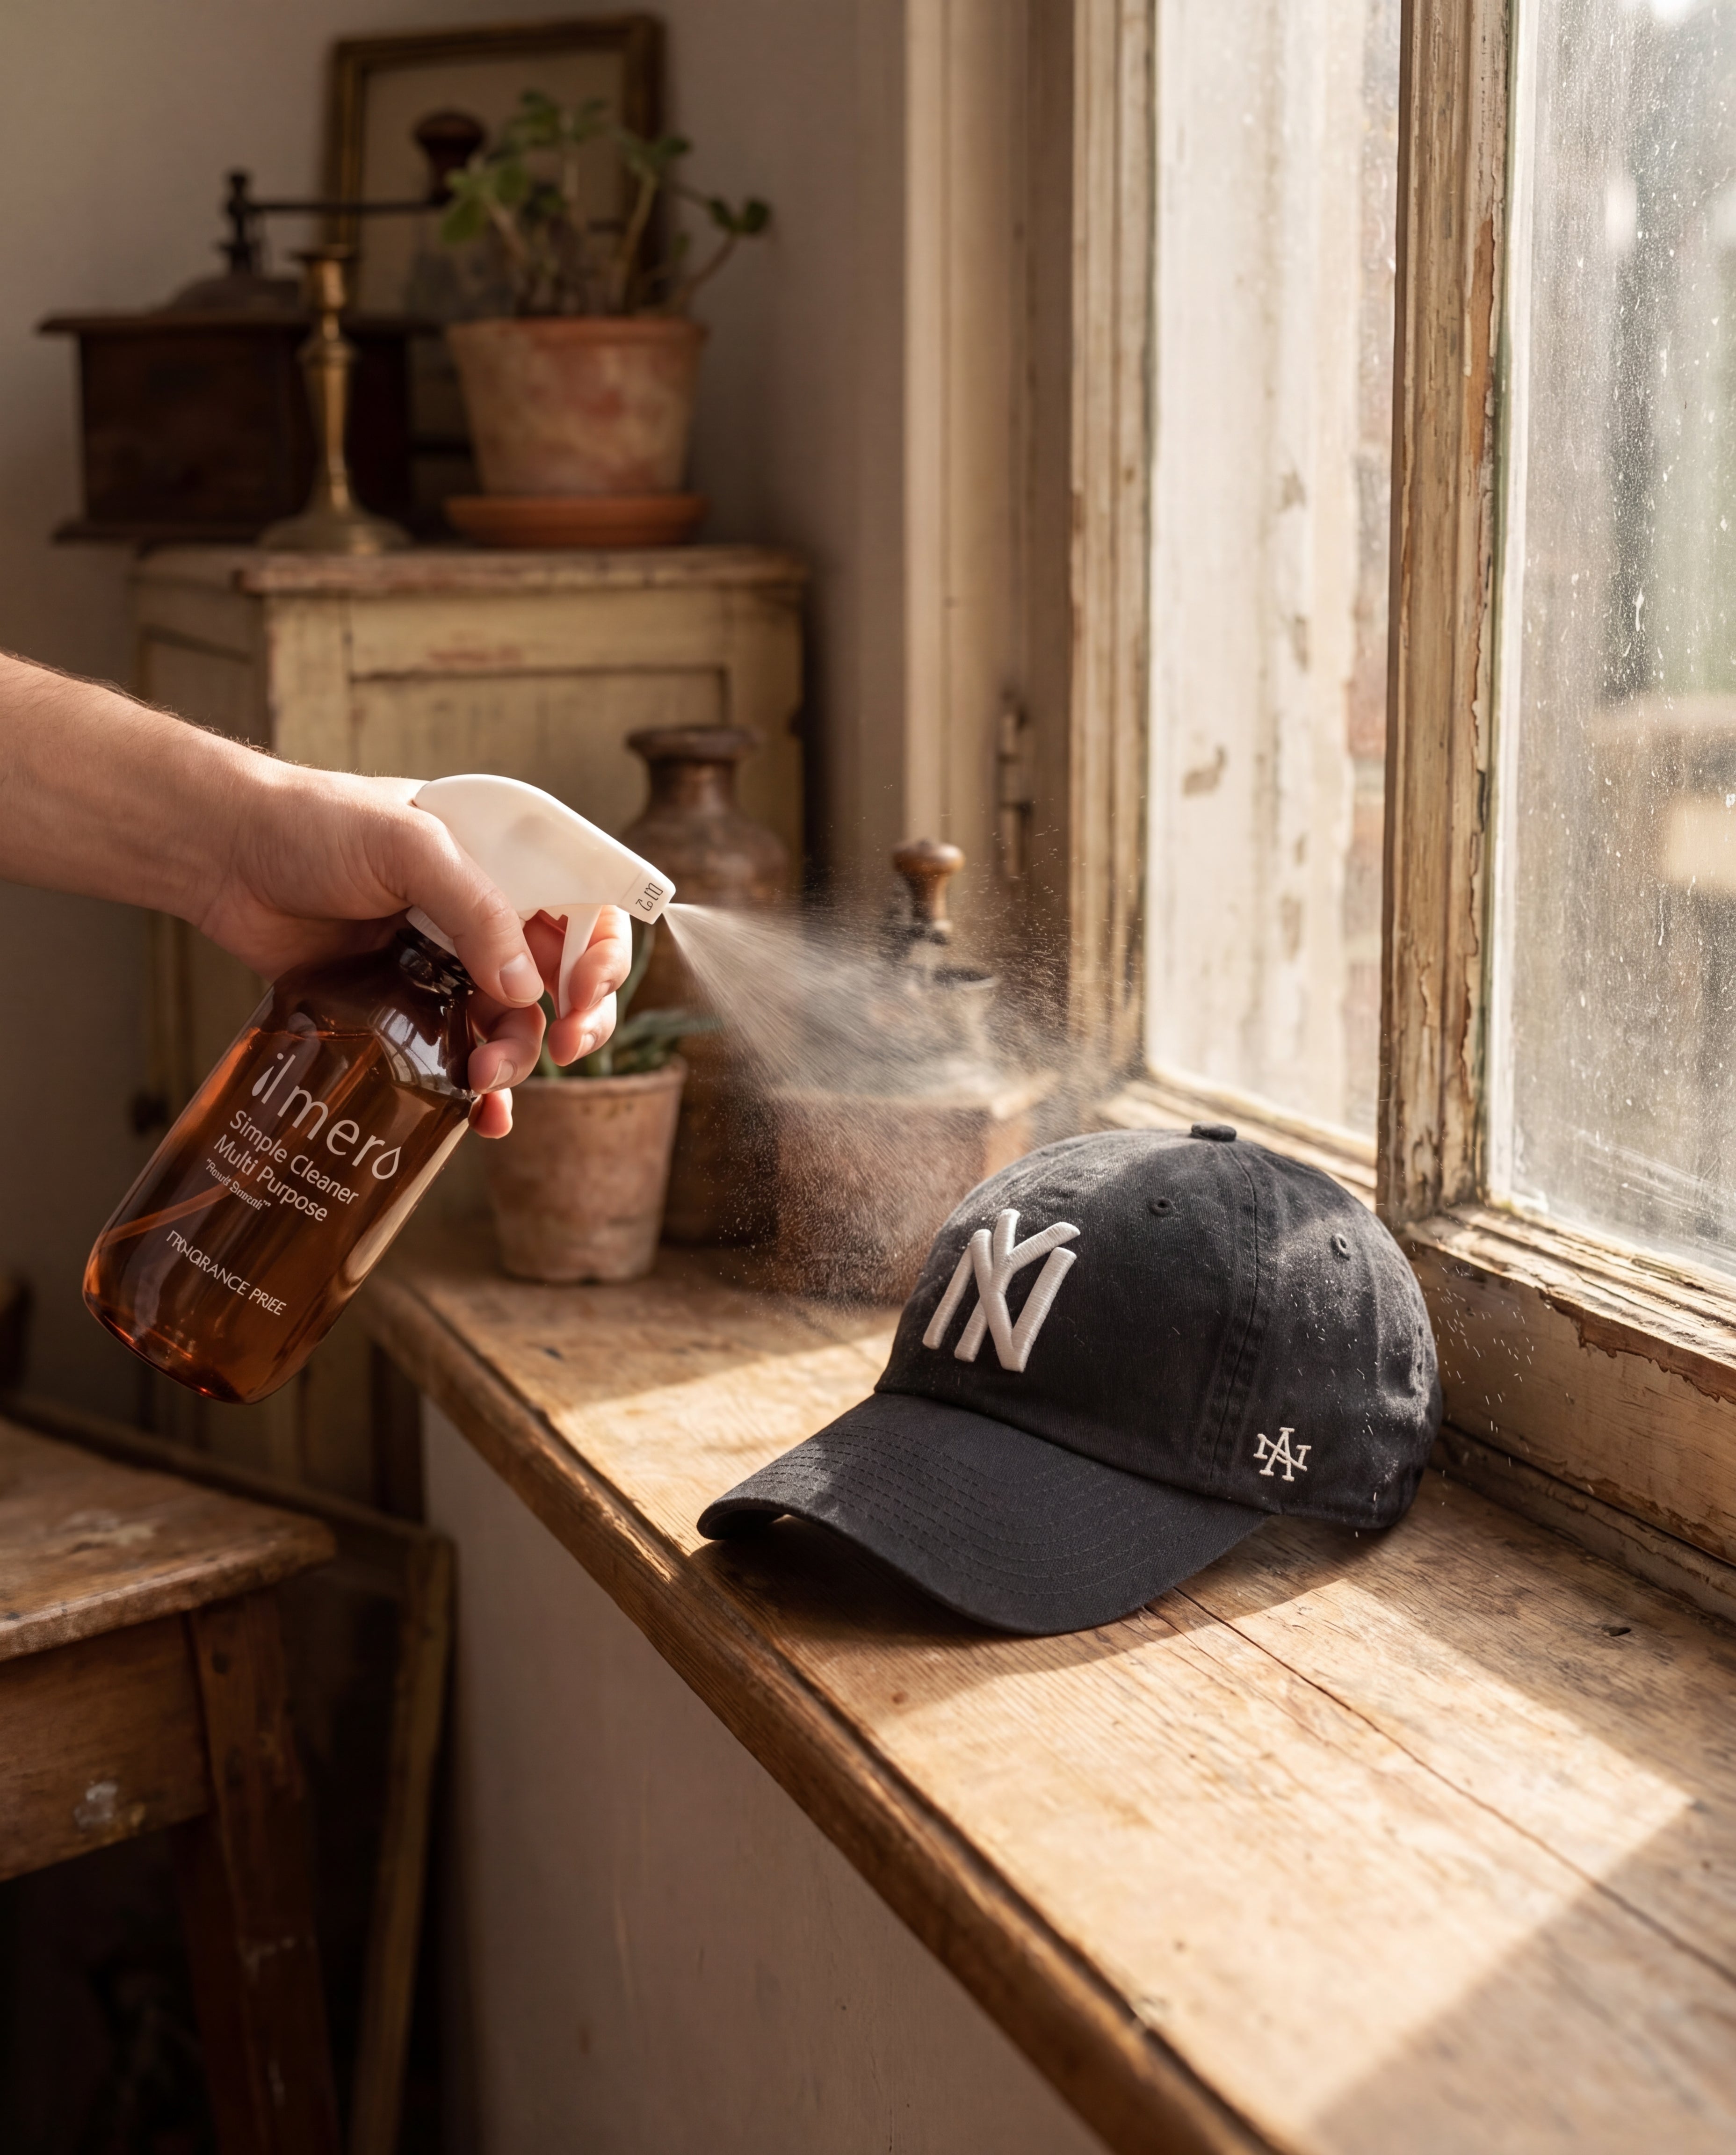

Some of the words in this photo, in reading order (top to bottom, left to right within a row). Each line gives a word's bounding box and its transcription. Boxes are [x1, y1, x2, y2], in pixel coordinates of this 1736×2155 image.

[213, 1134, 259, 1176] Multi
[256, 1165, 328, 1222] Purpose
[230, 1110, 288, 1163] Simple
[290, 1155, 359, 1205] Cleaner
